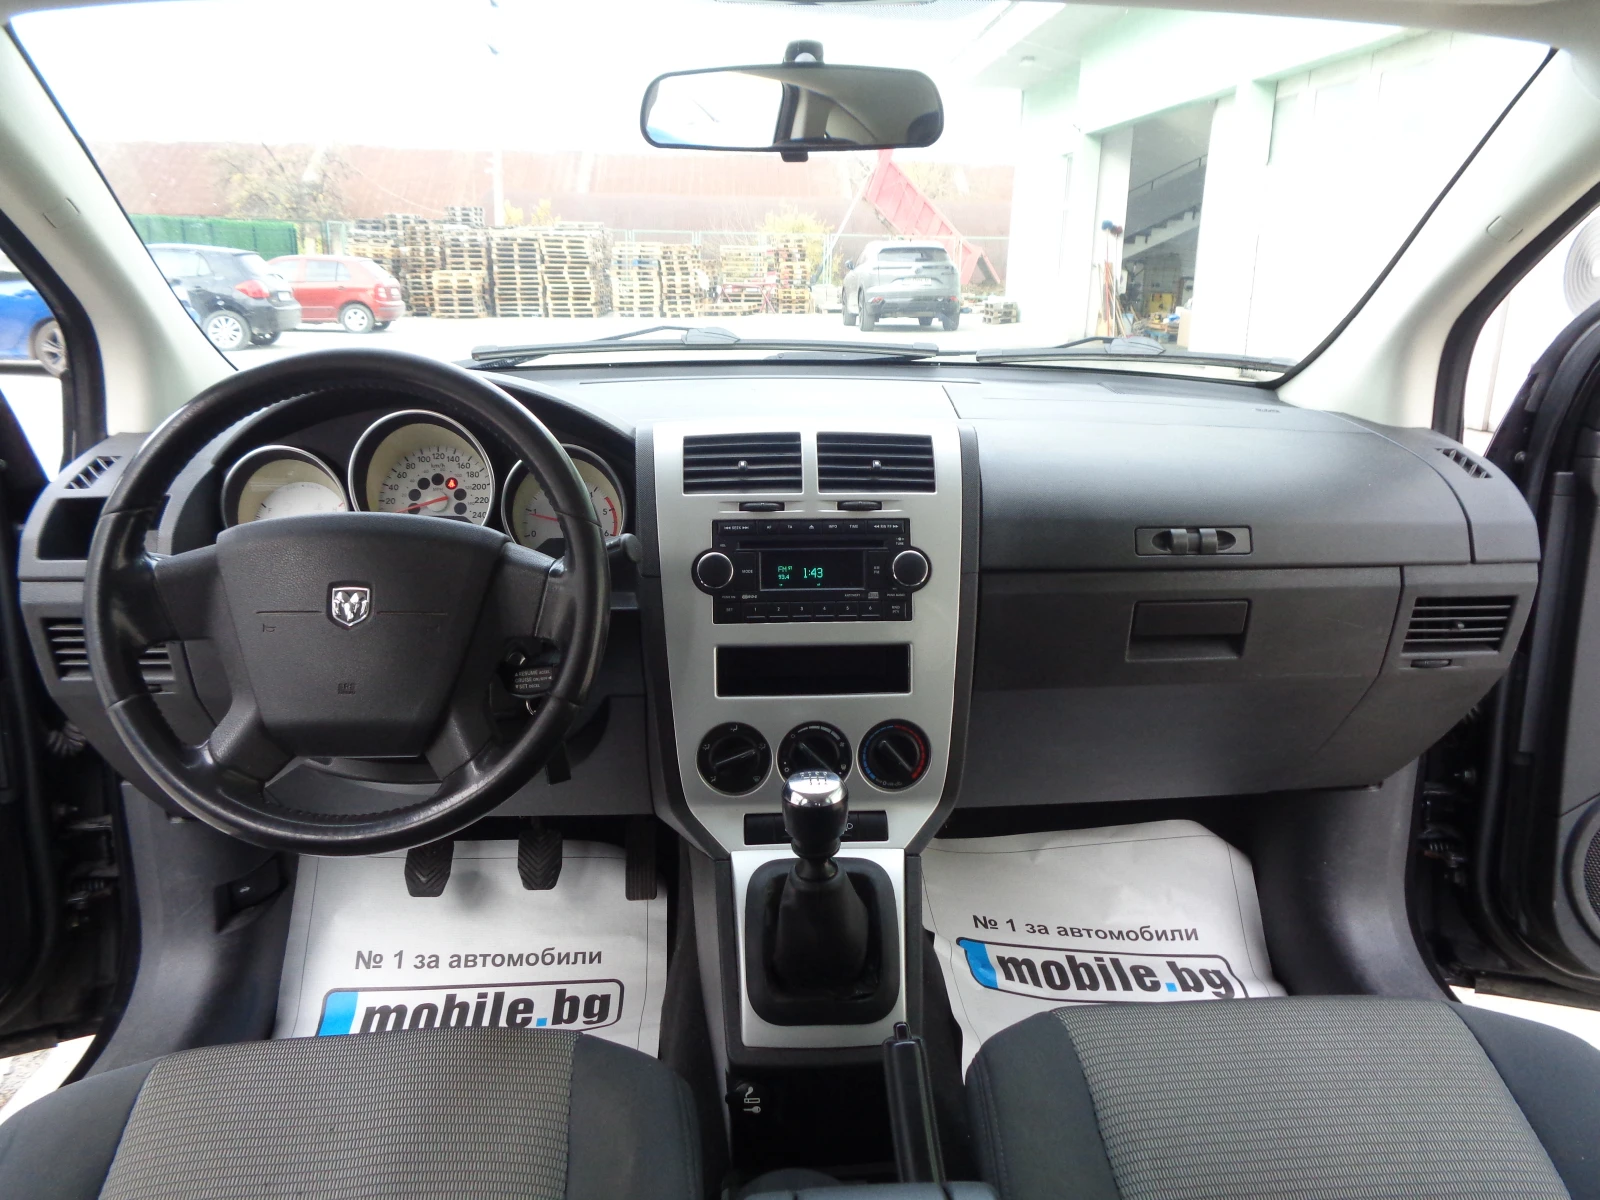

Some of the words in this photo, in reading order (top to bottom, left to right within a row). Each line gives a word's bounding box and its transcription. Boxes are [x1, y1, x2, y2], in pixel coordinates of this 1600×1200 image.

[804, 568, 824, 578] 1:43
[973, 914, 999, 930] №
[1006, 918, 1016, 932] 1
[1025, 922, 1050, 936] за
[1056, 924, 1200, 943] автомобили
[354, 950, 384, 970] №
[393, 949, 404, 970] 1
[413, 953, 440, 970] за
[447, 946, 603, 969] автомобили
[995, 954, 1235, 999] mobile.bg
[359, 988, 612, 1034] mobile.bg
